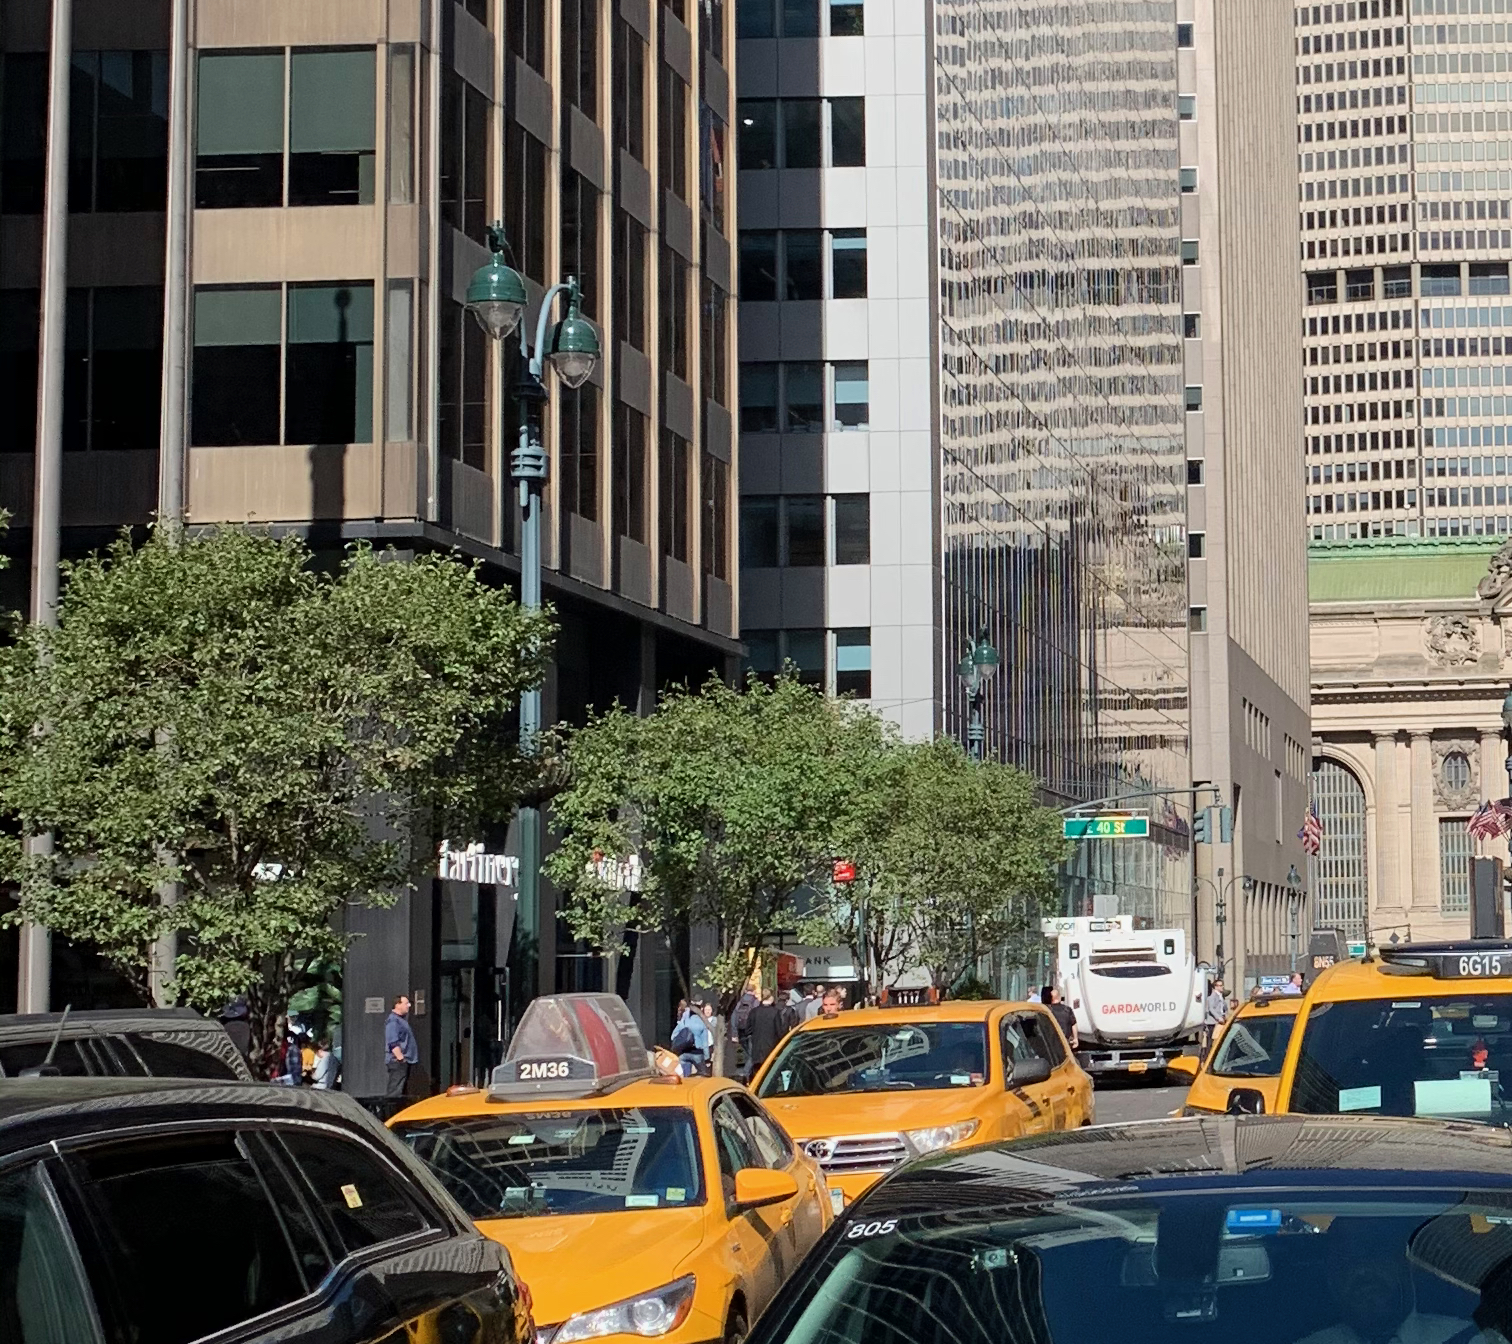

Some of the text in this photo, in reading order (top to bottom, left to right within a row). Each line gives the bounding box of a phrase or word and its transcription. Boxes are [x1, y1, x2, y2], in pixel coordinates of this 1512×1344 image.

[1096, 821, 1111, 834] 40
[1113, 820, 1126, 833] St
[805, 956, 831, 965] ANK
[1459, 956, 1501, 975] 6G15
[1102, 1001, 1176, 1015] GARDAWORLD
[519, 1061, 570, 1079] 2M36
[848, 1219, 899, 1238] 805
